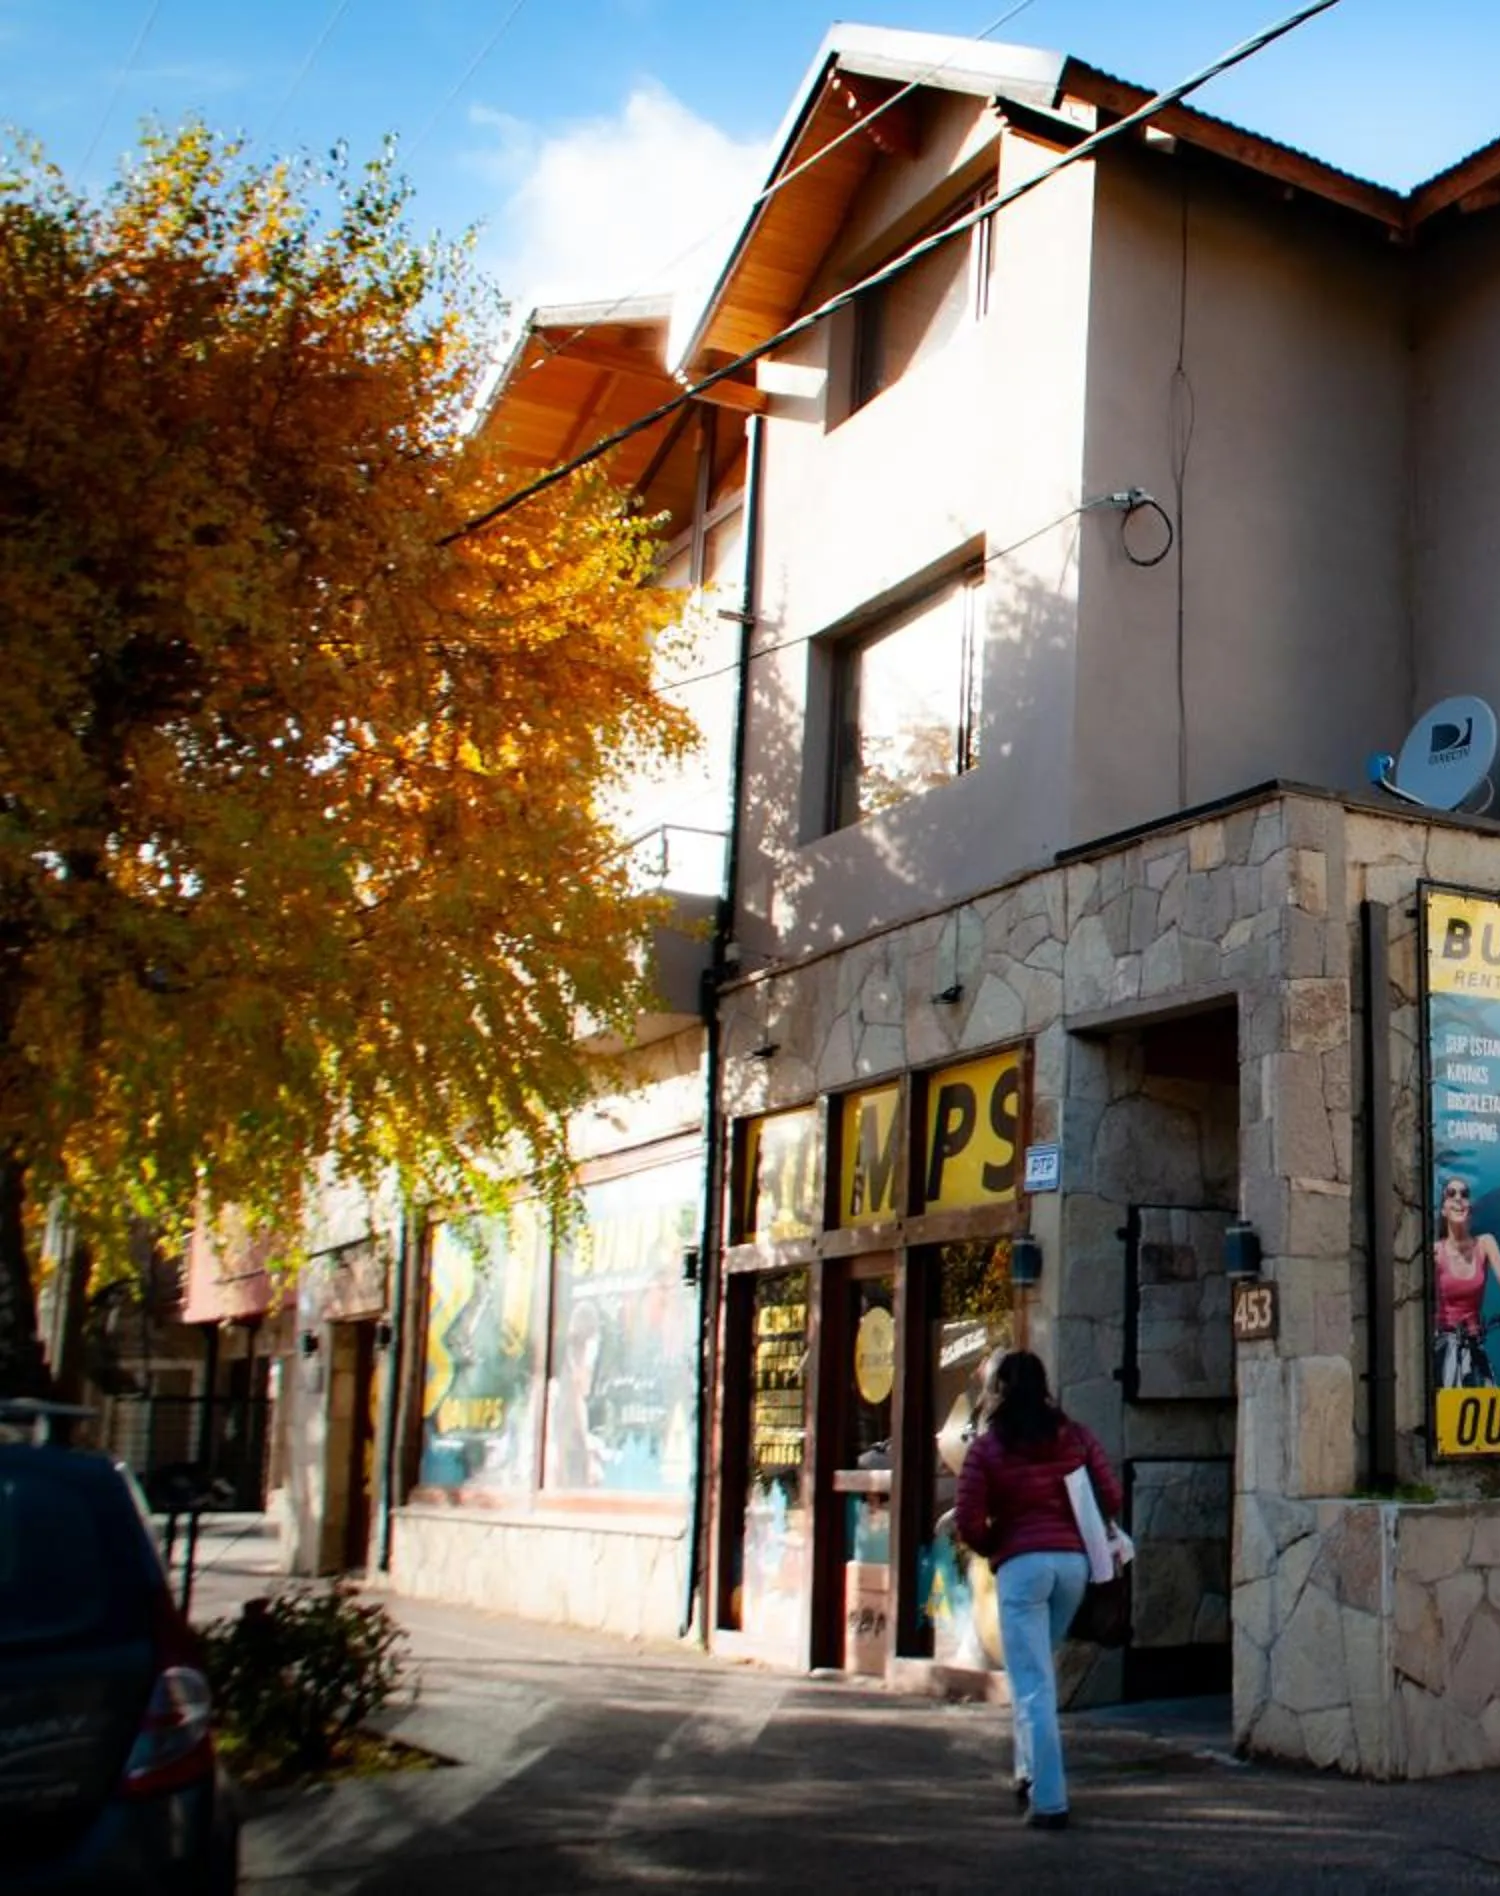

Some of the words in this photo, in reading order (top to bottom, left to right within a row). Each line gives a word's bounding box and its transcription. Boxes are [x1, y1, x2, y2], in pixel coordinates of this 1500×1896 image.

[1446, 1062, 1489, 1085] KAYAKS
[1446, 1120, 1499, 1143] CAMPING
[1234, 1288, 1272, 1331] 453
